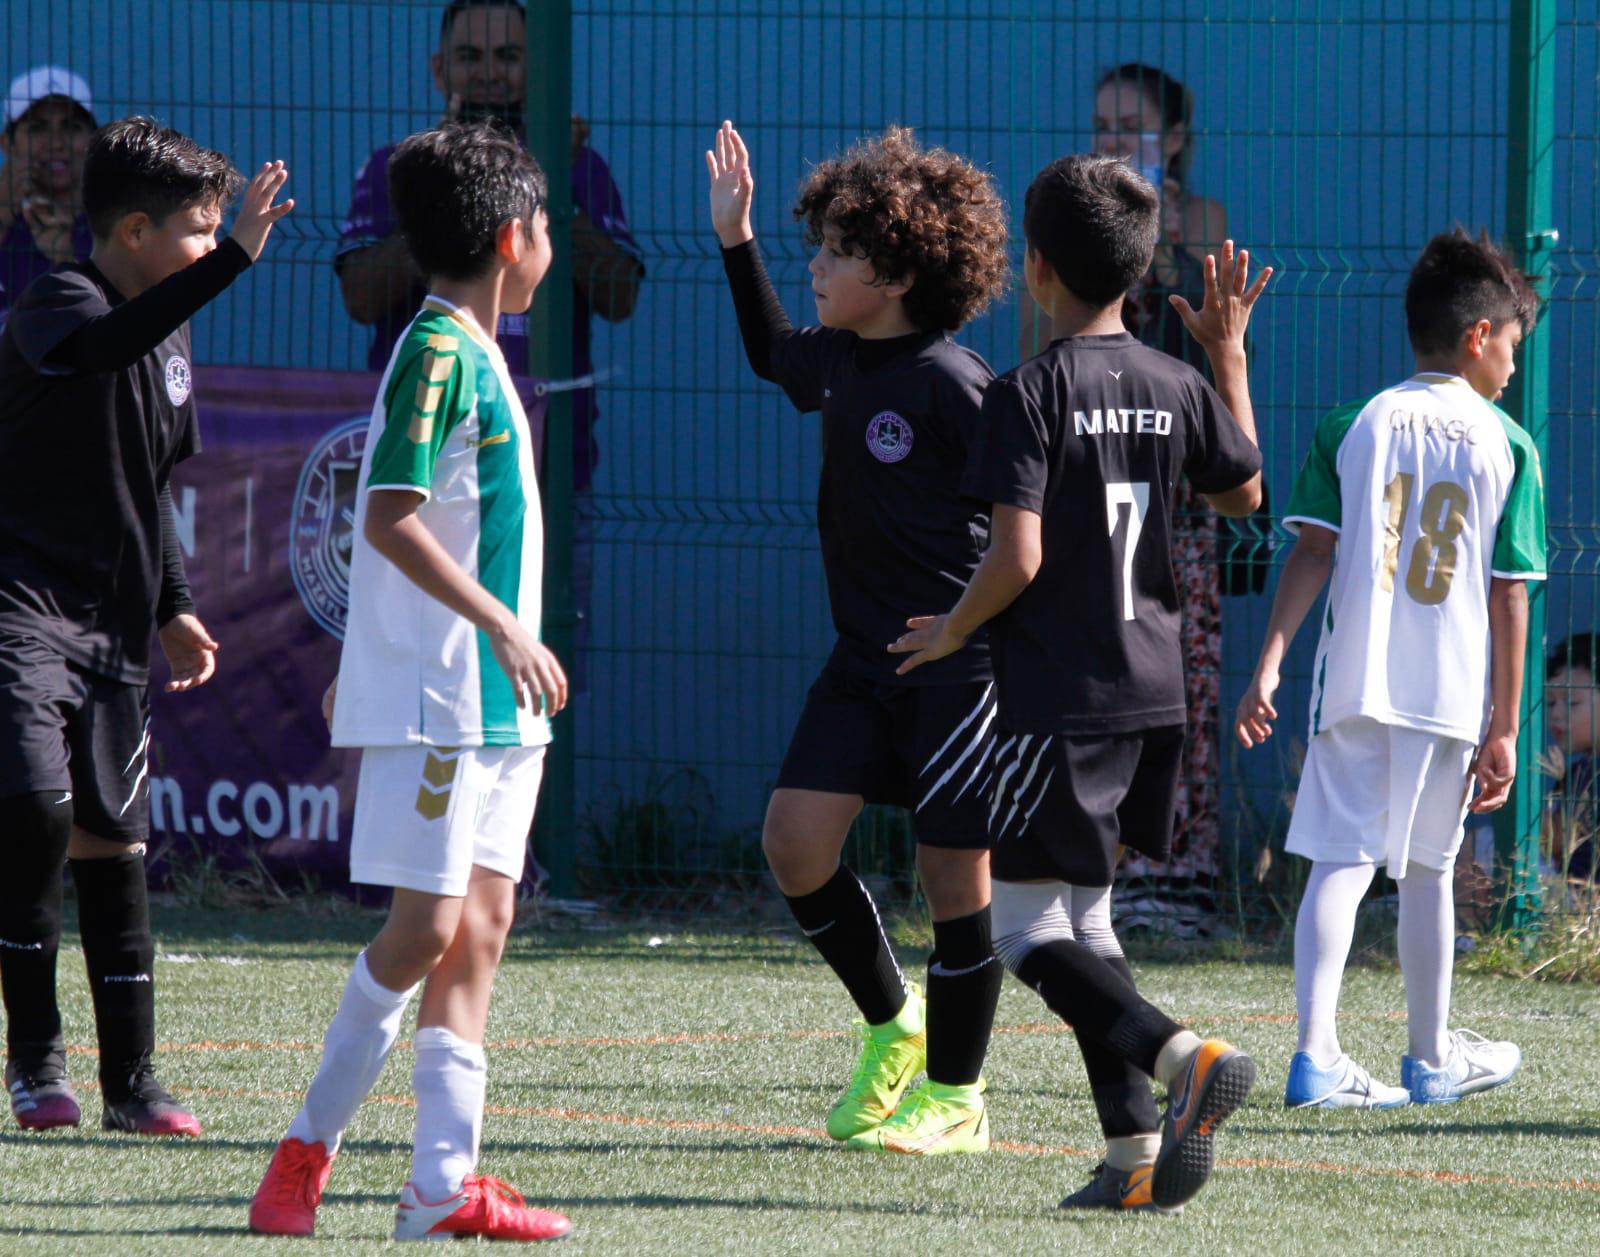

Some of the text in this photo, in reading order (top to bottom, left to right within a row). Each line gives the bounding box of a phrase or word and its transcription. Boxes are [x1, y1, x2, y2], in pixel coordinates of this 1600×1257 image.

[1074, 408, 1173, 436] MATEO
[1106, 482, 1150, 621] 7
[1380, 472, 1469, 605] 18
[148, 776, 340, 842] n.com
